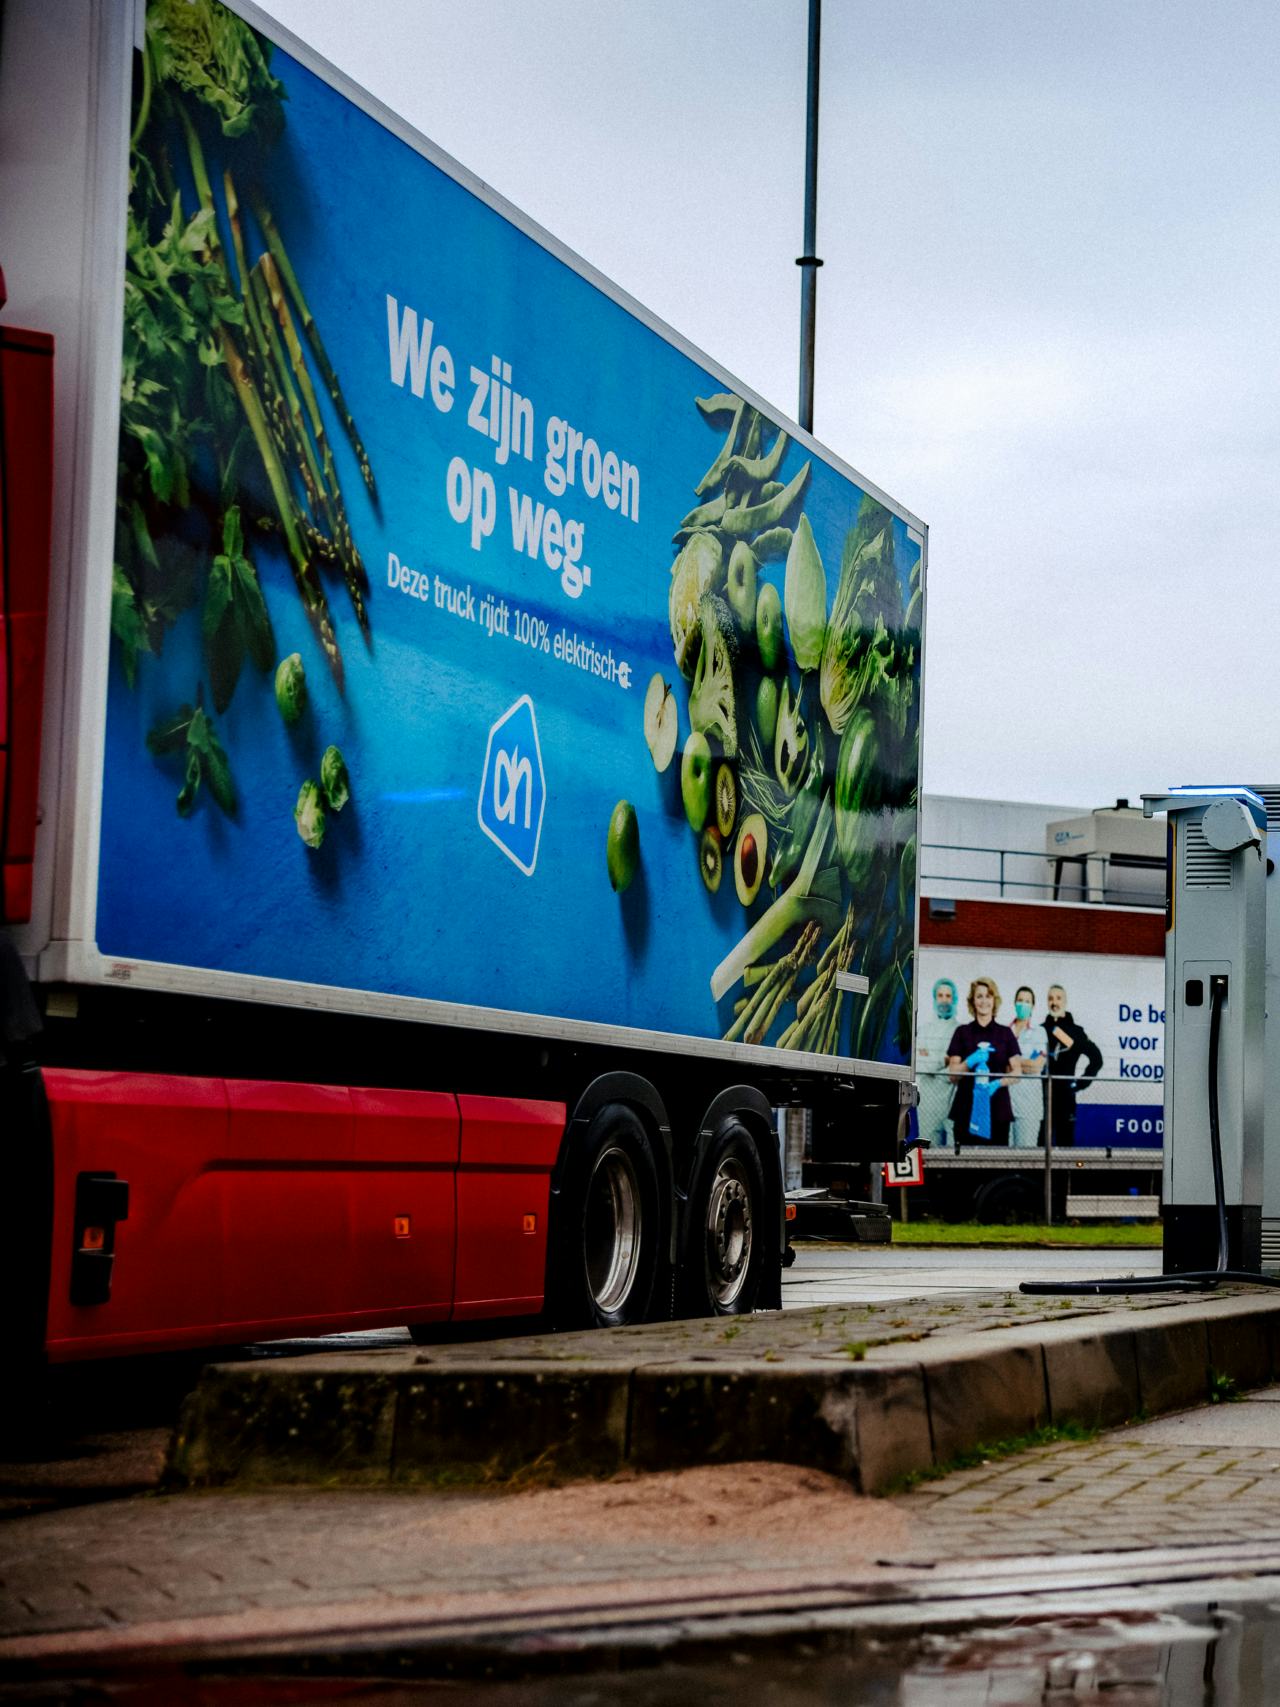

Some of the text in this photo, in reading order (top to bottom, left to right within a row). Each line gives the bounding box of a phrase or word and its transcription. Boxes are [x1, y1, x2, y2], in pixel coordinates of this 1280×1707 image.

[386, 293, 640, 523] We zijn groen
[446, 456, 591, 599] op weg.
[387, 552, 616, 682] Deze truck rijdt 100% elektrisch
[1119, 1004, 1142, 1023] De
[1118, 1036, 1159, 1051] voor
[1119, 1058, 1165, 1080] koop
[1116, 1118, 1164, 1133] FOOD
